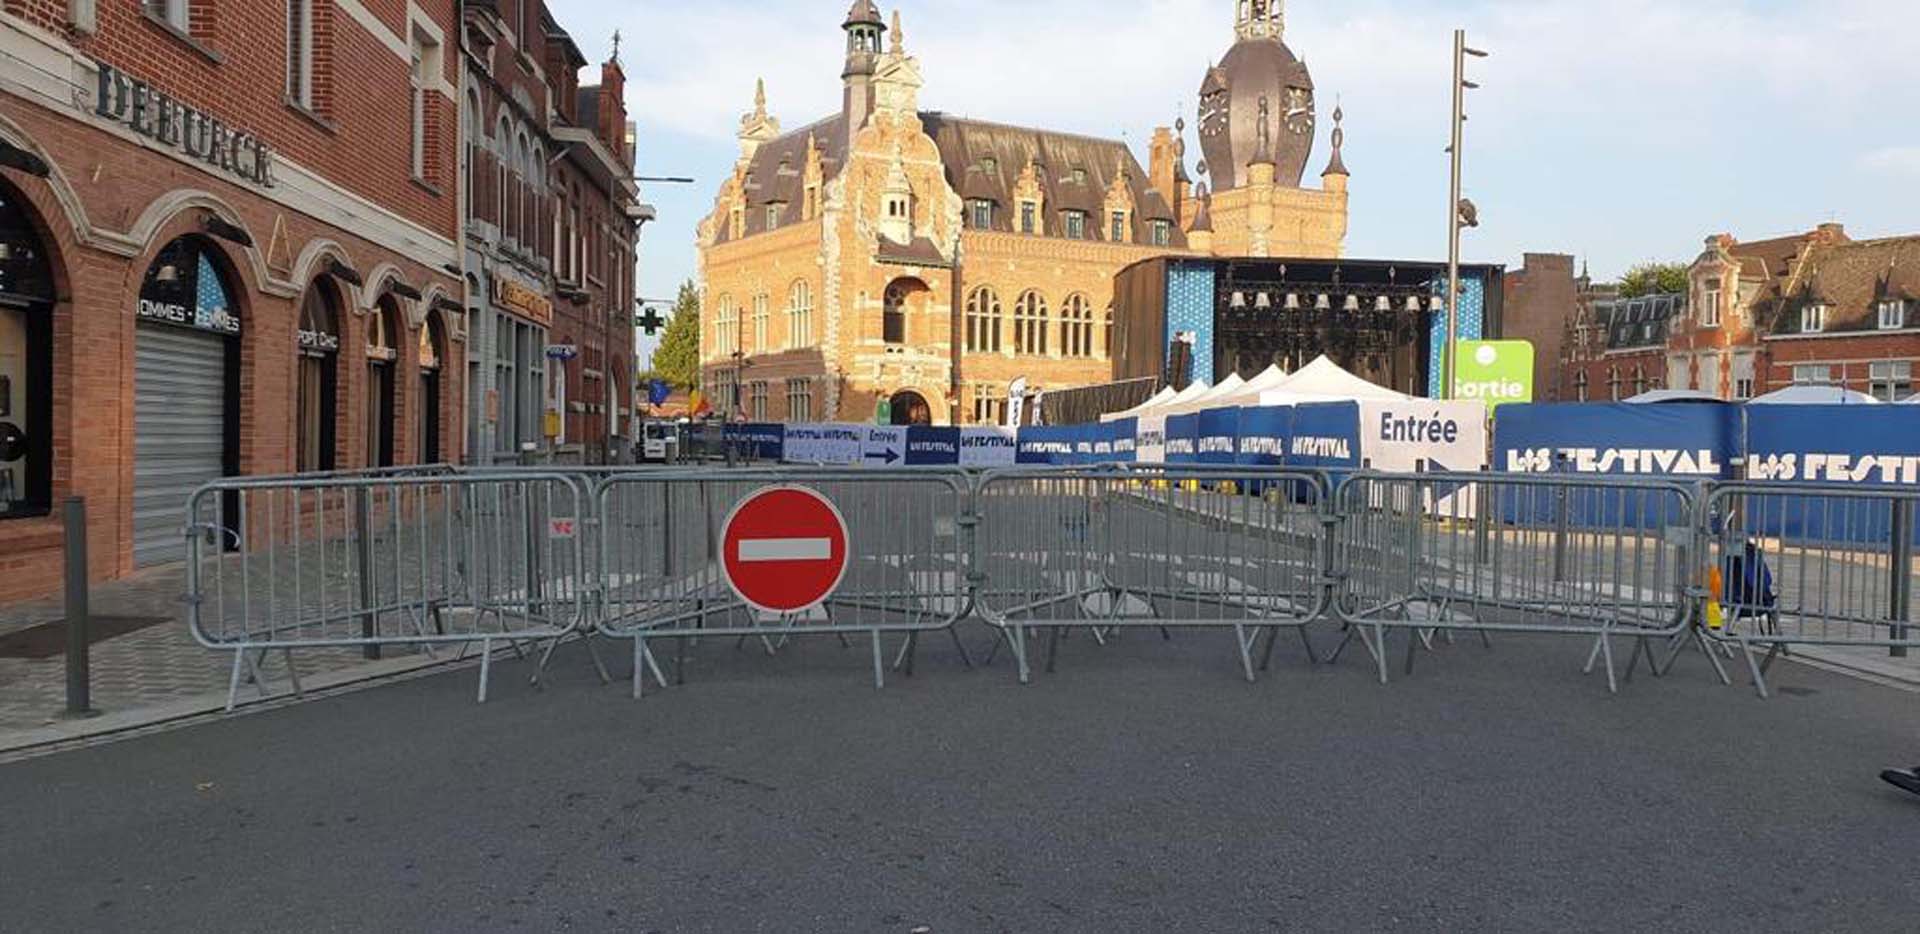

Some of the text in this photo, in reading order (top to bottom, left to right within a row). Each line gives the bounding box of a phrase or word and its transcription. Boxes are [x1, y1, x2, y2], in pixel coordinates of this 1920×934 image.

[95, 61, 275, 188] DEBURCK
[1380, 411, 1458, 443] Entrée
[1803, 454, 1920, 485] FESTI
